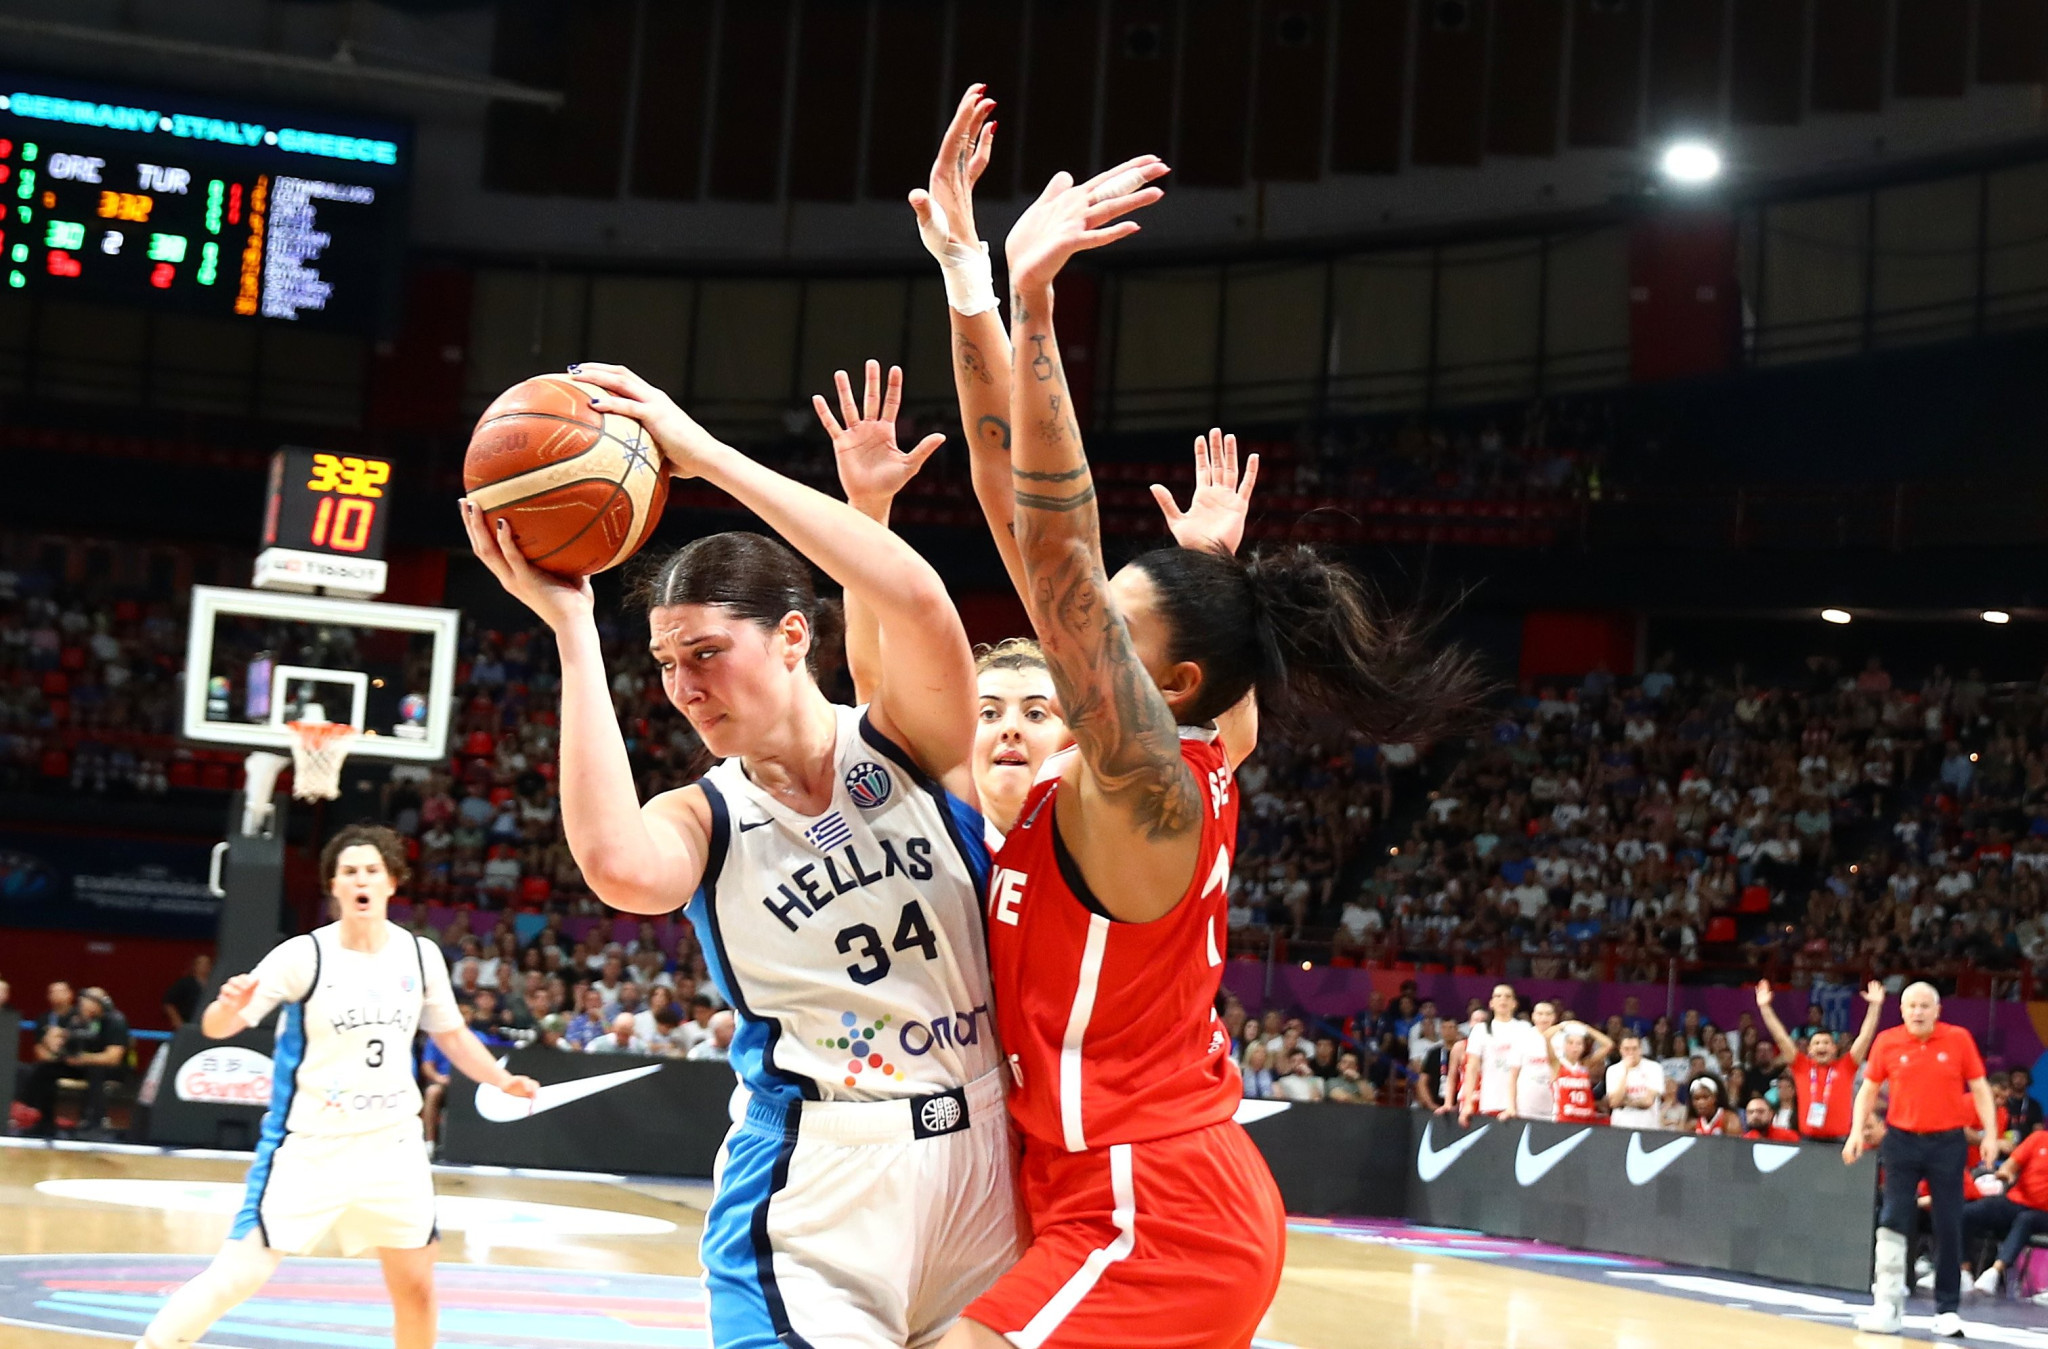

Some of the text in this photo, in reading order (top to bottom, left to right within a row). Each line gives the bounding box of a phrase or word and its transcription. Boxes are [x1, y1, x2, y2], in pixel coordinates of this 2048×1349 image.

[171, 113, 266, 147] ITALY
[277, 128, 398, 165] GREECE
[137, 163, 191, 195] TUR
[101, 230, 124, 255] 2
[311, 496, 376, 552] 10
[763, 838, 933, 932] HELLAS
[834, 899, 938, 986] 34
[365, 1038, 385, 1068] 3
